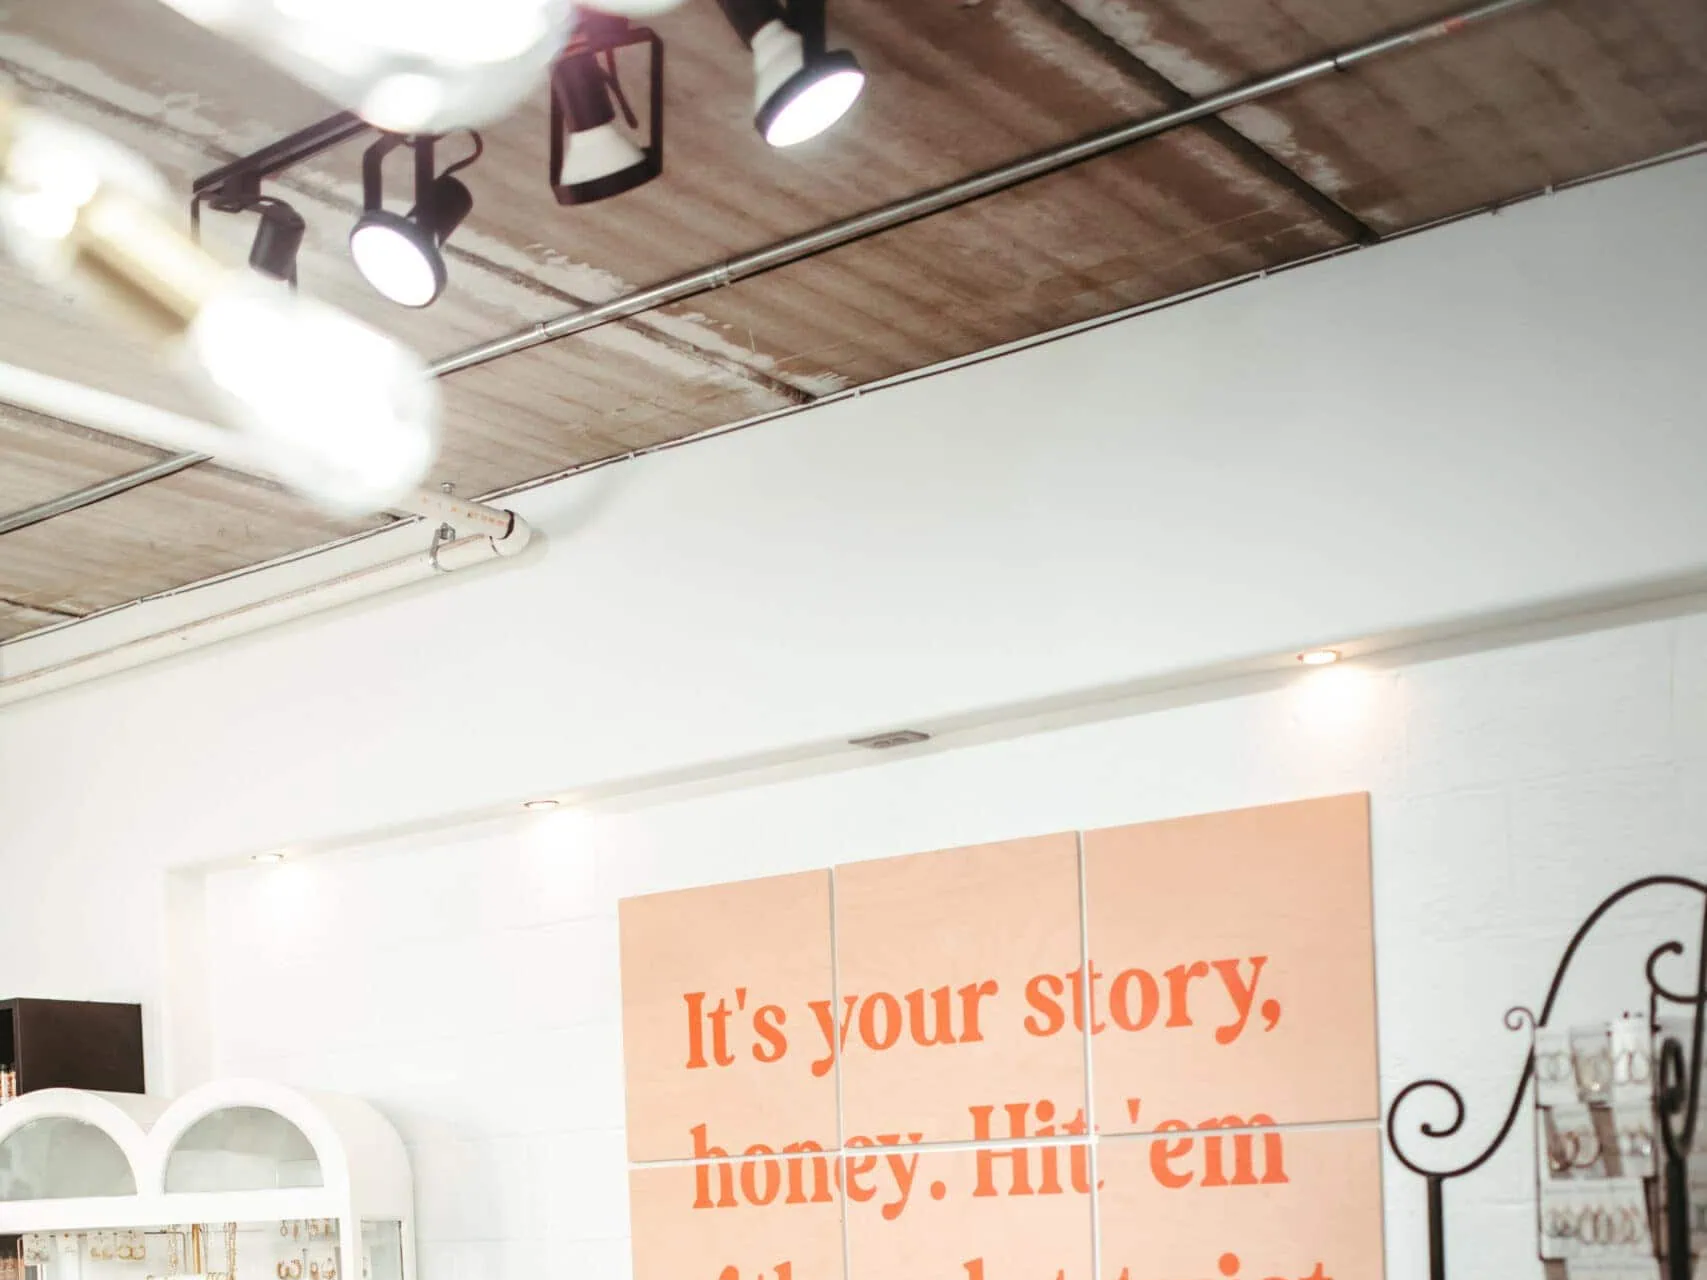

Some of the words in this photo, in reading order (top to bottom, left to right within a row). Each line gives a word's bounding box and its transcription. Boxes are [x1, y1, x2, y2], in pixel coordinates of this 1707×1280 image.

[685, 987, 787, 1070] It's
[808, 980, 997, 1077] your
[1025, 956, 1282, 1047] story,
[691, 1125, 945, 1219] honey.
[970, 1102, 1103, 1198] Hit
[1127, 1099, 1288, 1190] 'em
